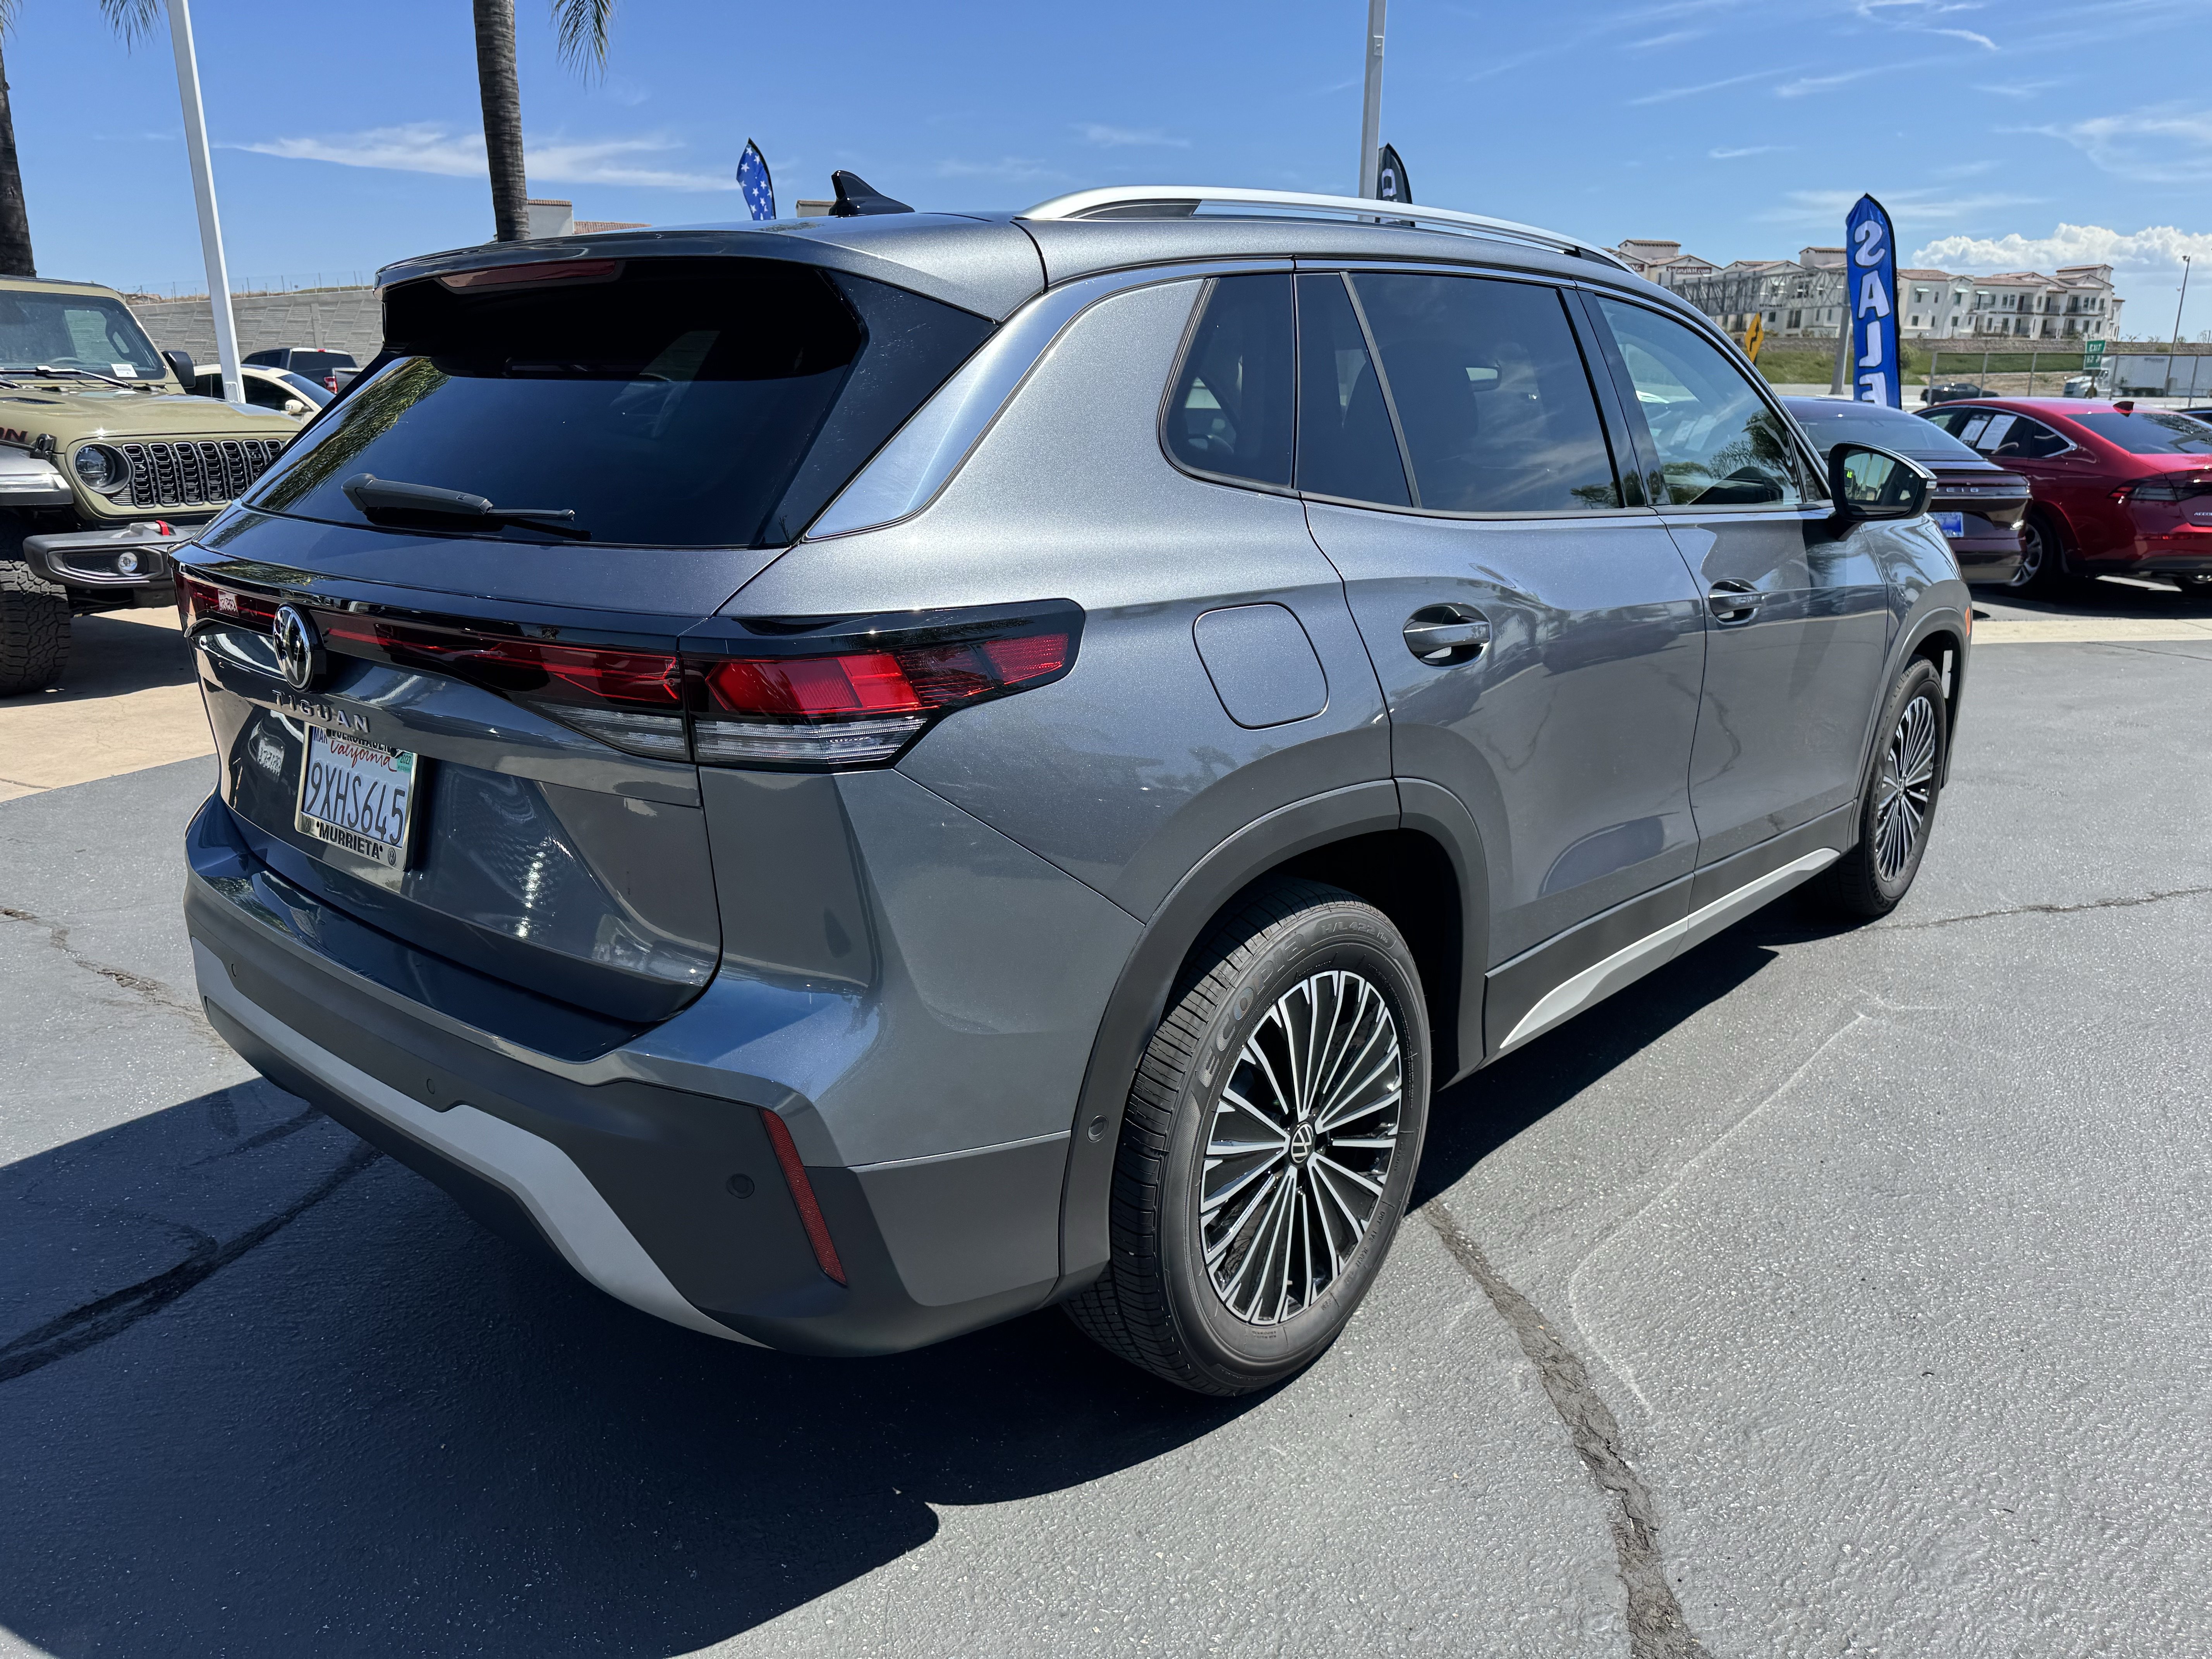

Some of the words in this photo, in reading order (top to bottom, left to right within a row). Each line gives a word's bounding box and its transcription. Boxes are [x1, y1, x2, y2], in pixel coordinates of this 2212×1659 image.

[2089, 343, 2102, 352] EXIT
[272, 689, 370, 733] TIGUAN
[330, 740, 397, 772] California
[306, 762, 405, 845] 9XHS645
[319, 822, 380, 860] MURRIETA
